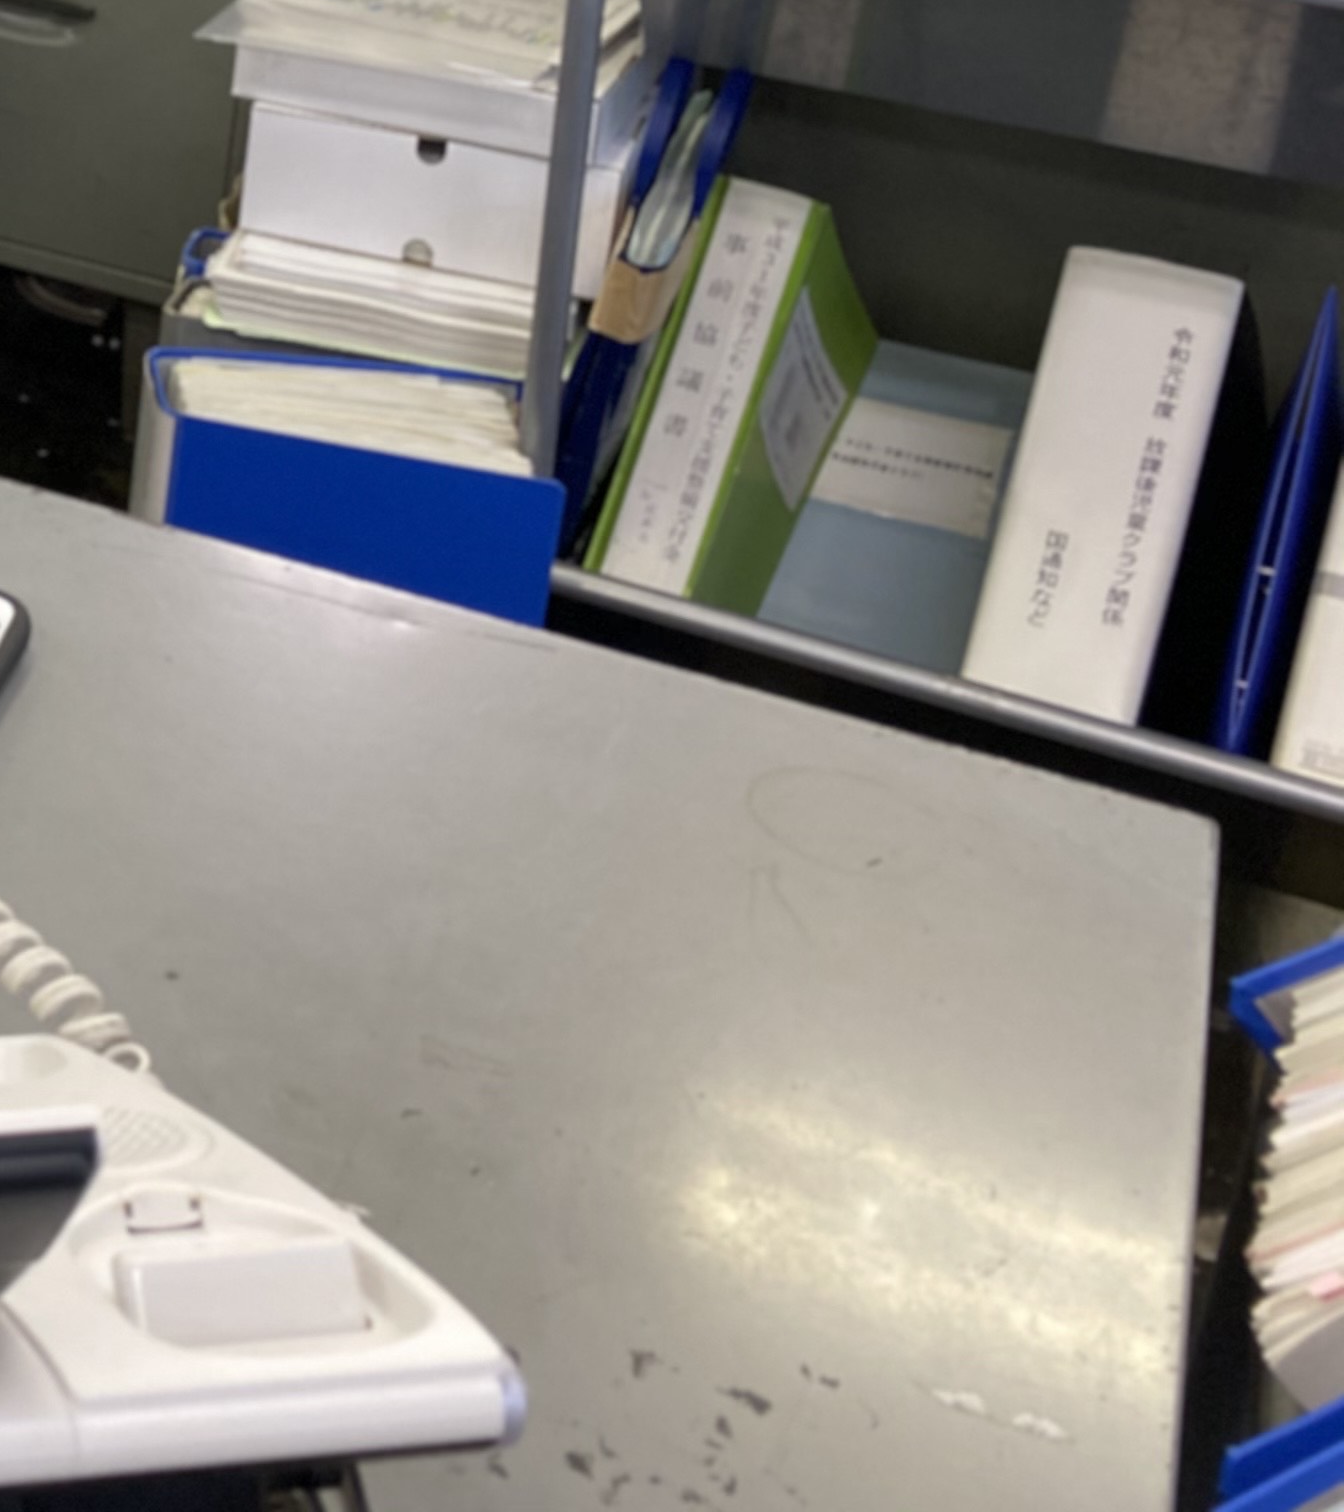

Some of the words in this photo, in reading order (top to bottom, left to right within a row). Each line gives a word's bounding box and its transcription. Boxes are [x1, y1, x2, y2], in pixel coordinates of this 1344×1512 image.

[1152, 327, 1193, 421] 令和元年度
[1026, 529, 1070, 628] 国通知など
[1102, 436, 1166, 627] 放課後児童クラブ関係
